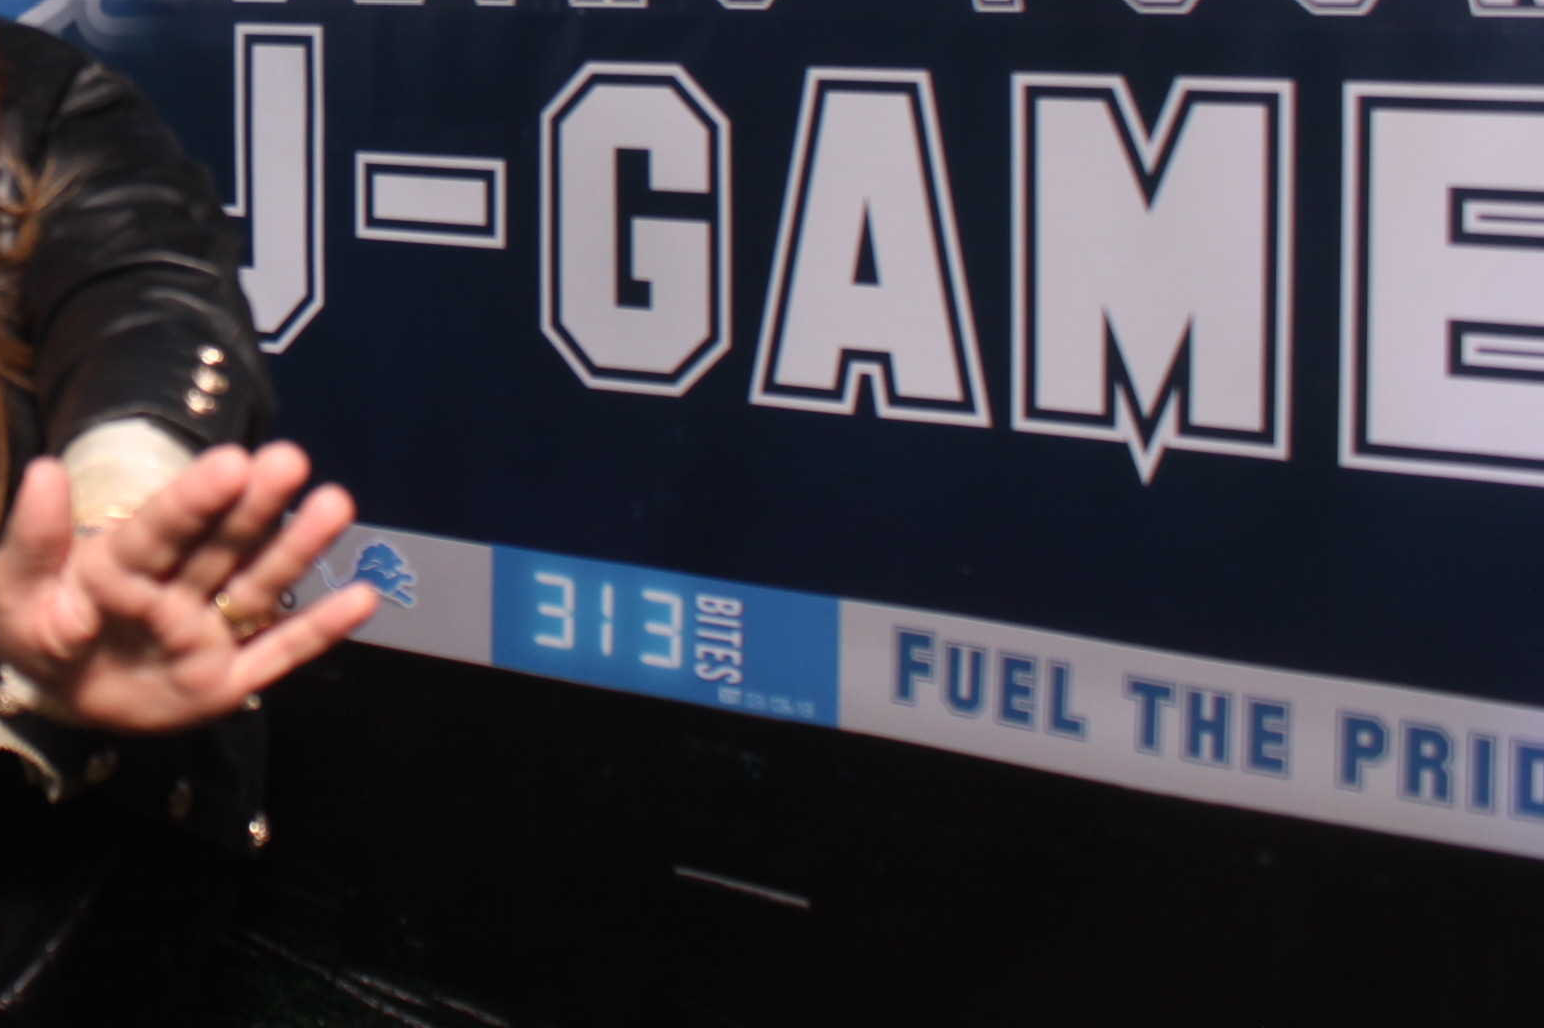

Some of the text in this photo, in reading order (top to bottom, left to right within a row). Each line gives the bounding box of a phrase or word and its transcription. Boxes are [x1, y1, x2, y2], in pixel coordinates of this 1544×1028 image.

[533, 571, 683, 670] 313
[693, 592, 743, 684] BITES
[891, 624, 1090, 741] FUEL
[1122, 673, 1293, 780] THE
